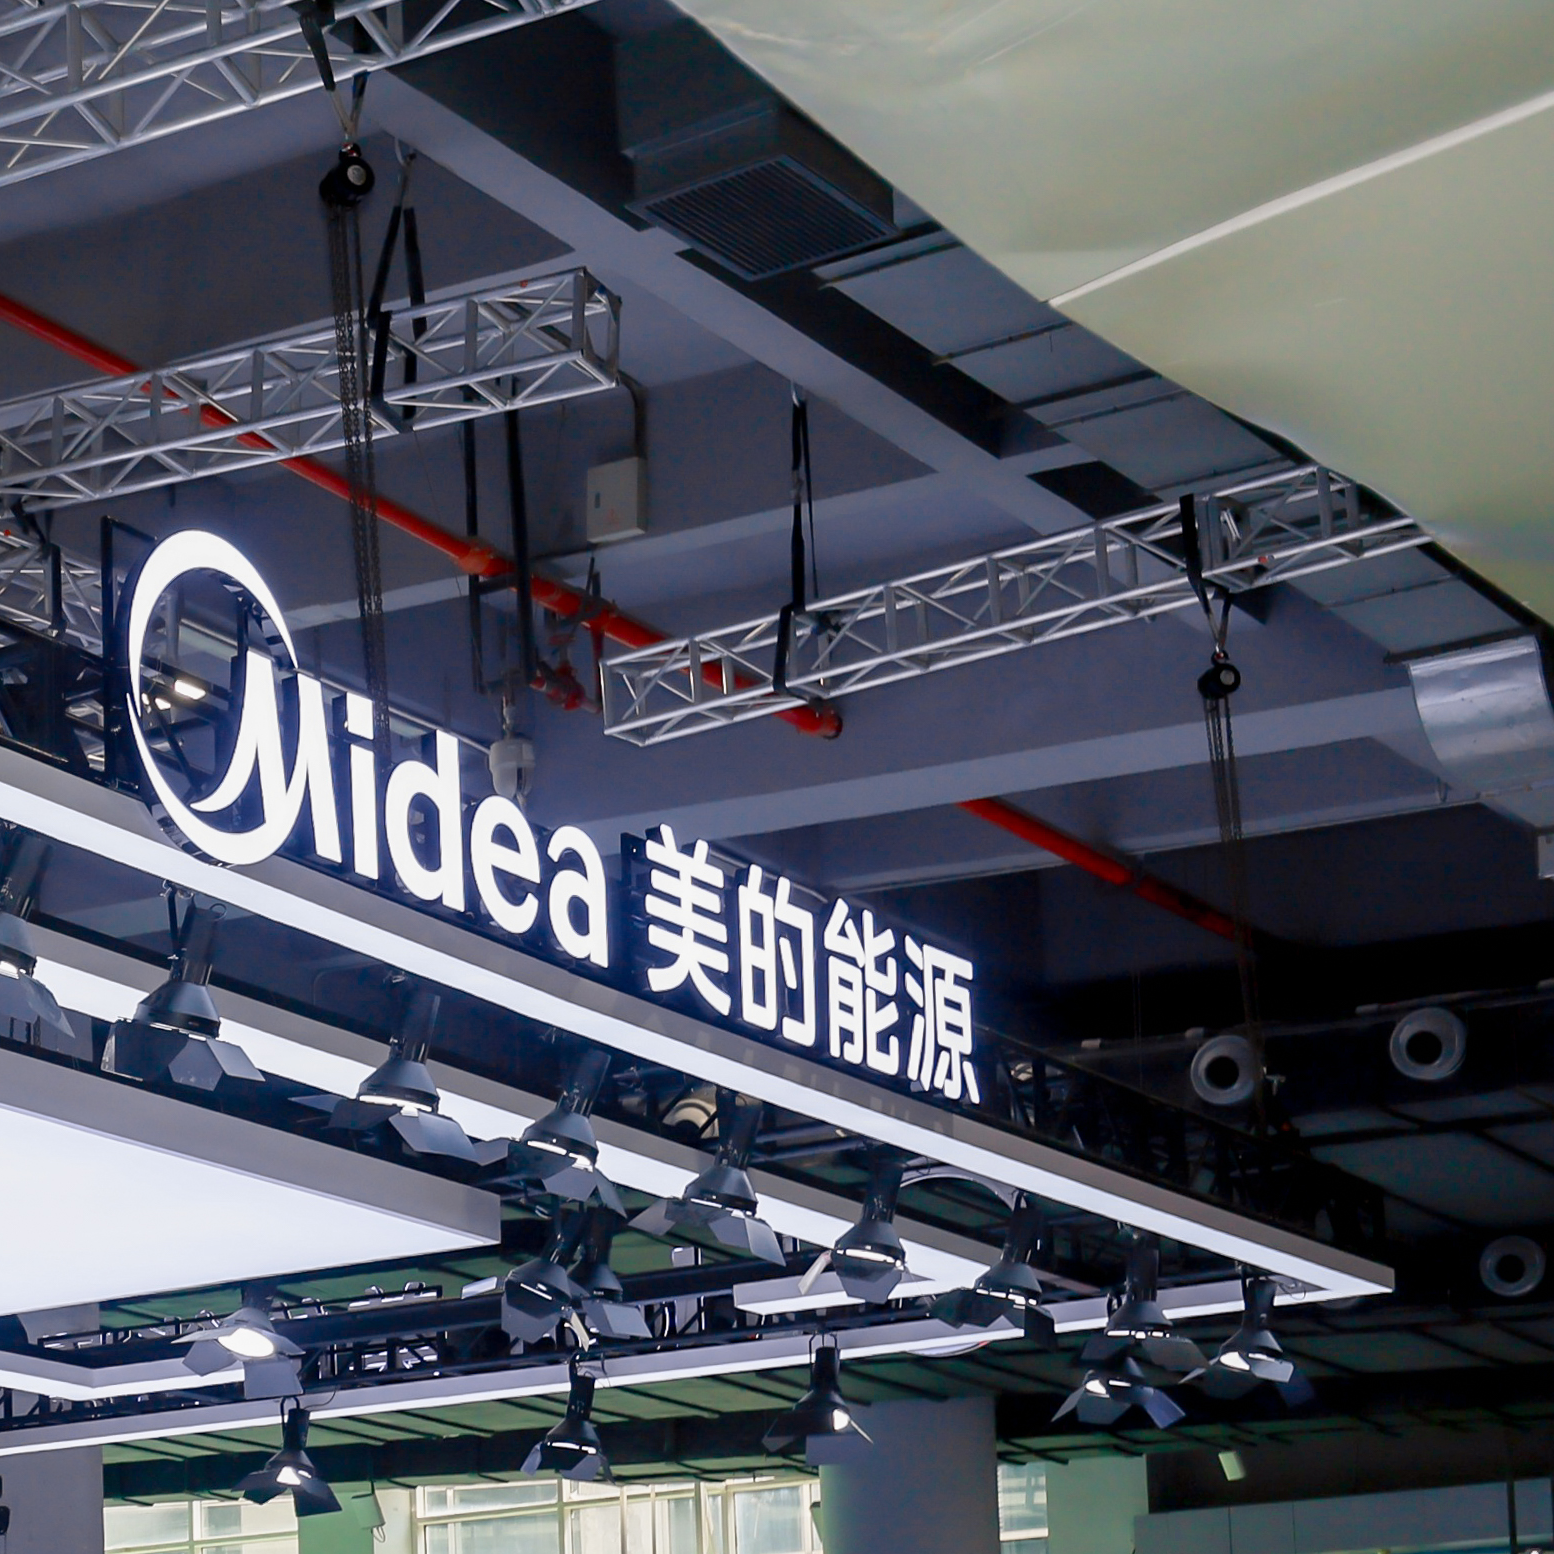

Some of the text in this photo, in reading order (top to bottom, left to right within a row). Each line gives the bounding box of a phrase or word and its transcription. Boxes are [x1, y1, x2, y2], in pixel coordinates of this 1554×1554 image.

[126, 529, 980, 1105] Midea 美的能源
